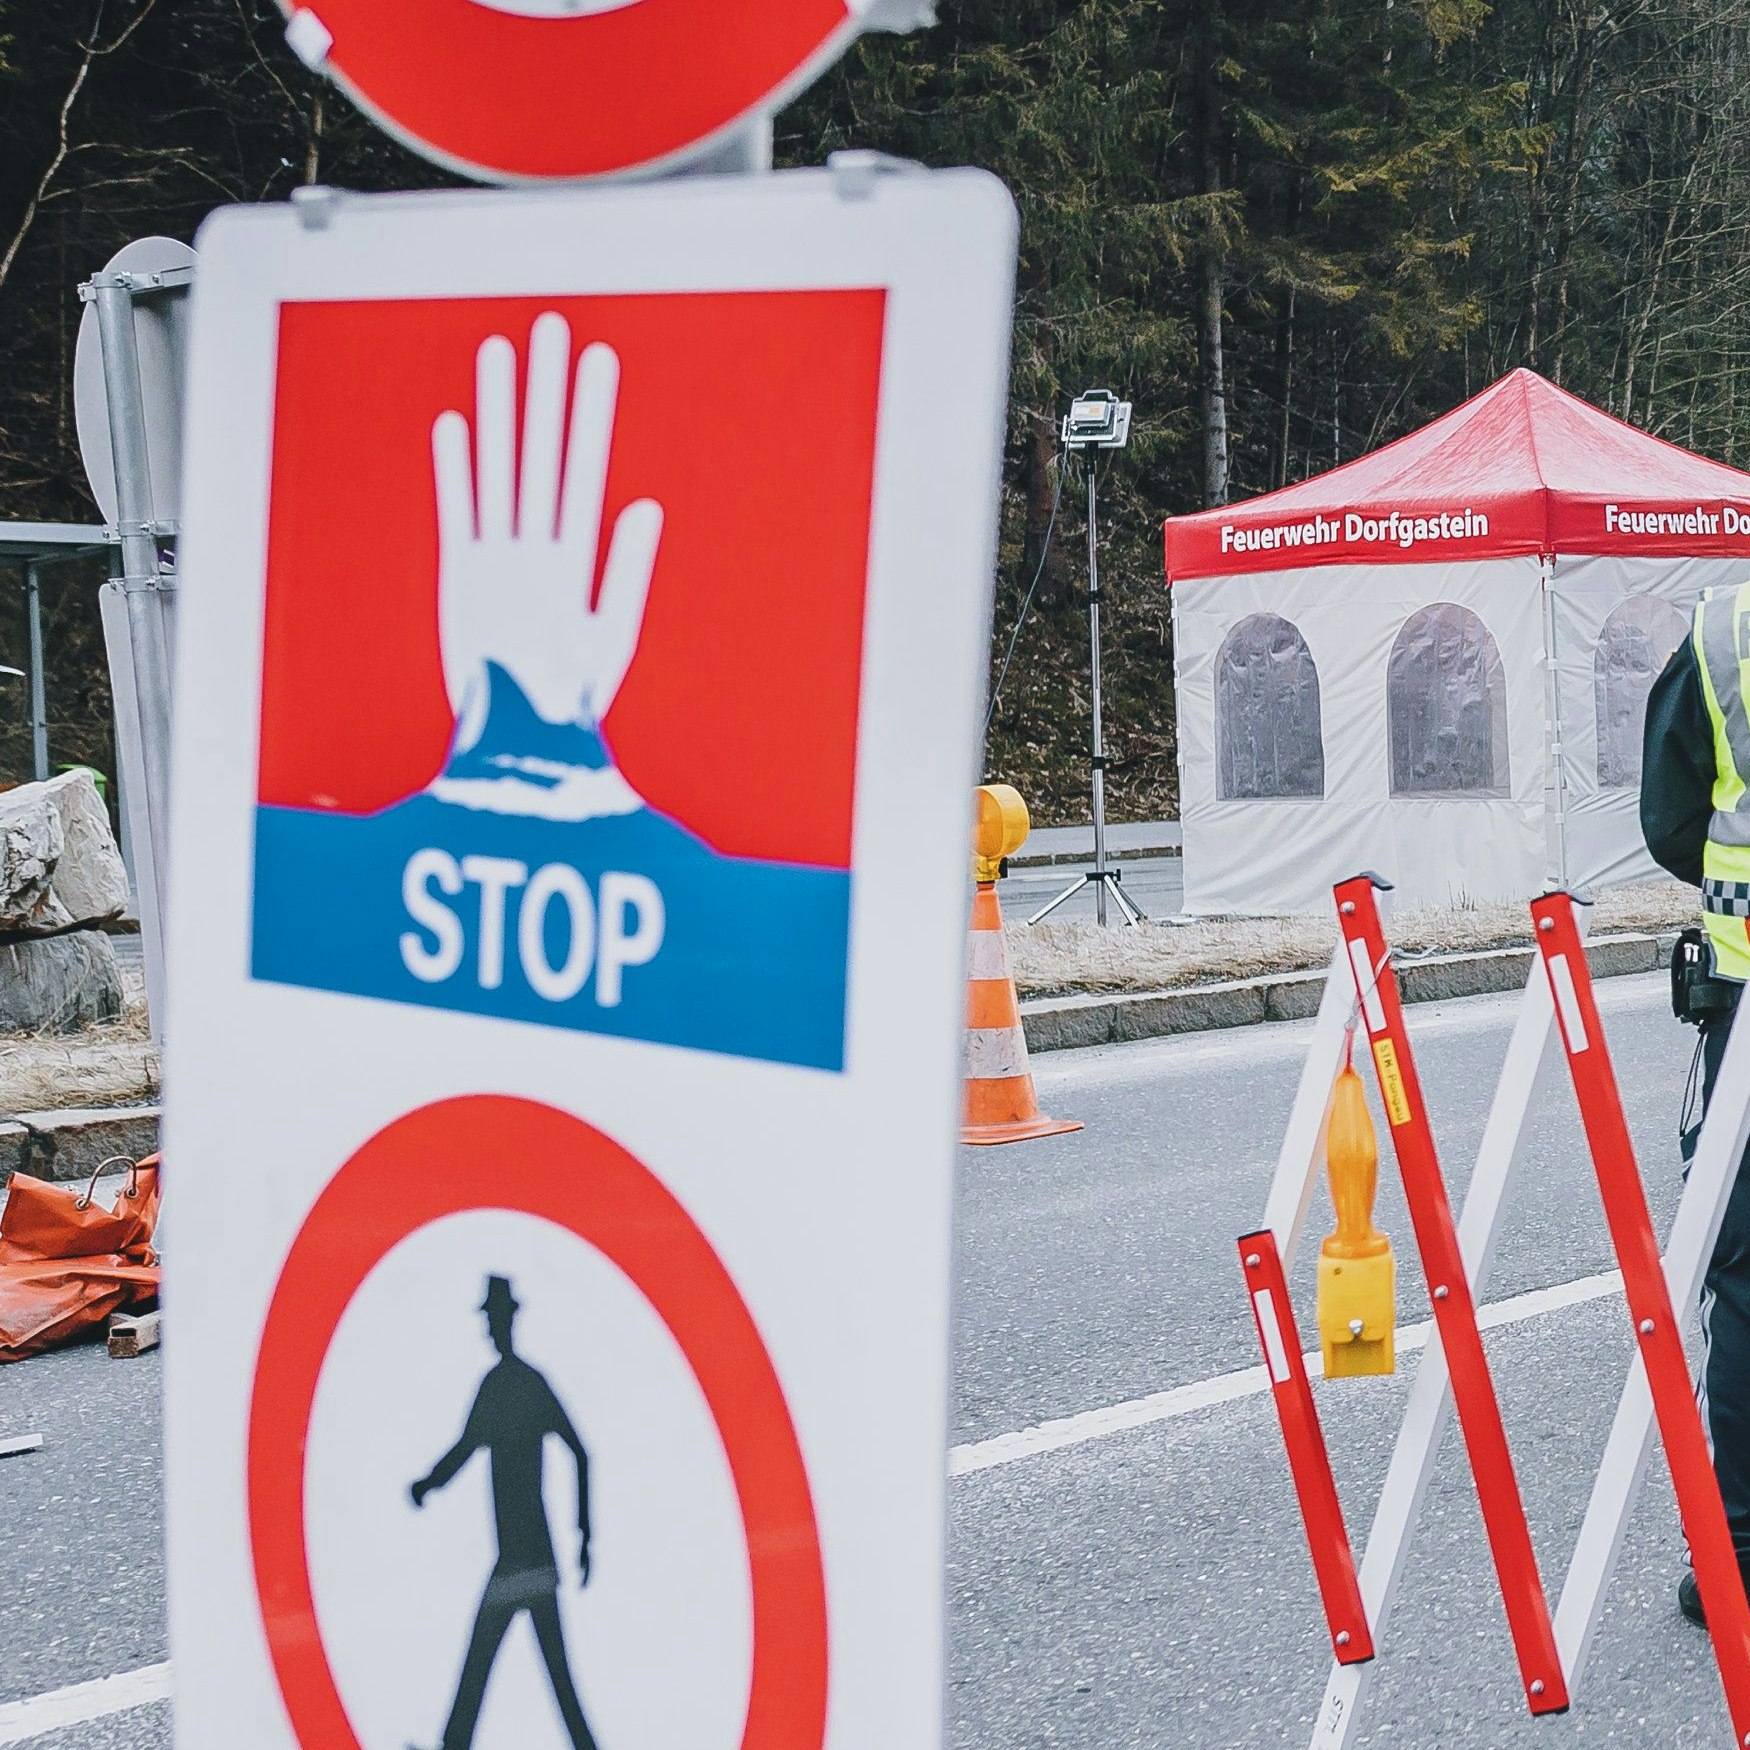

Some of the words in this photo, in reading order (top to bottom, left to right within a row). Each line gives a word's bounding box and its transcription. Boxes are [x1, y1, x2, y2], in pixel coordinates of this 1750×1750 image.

[1221, 515, 1340, 553] Feuerwehr
[1345, 508, 1489, 548] Dorfgastein
[1605, 504, 1719, 534] Feuerwehr
[399, 846, 666, 1009] STOP
